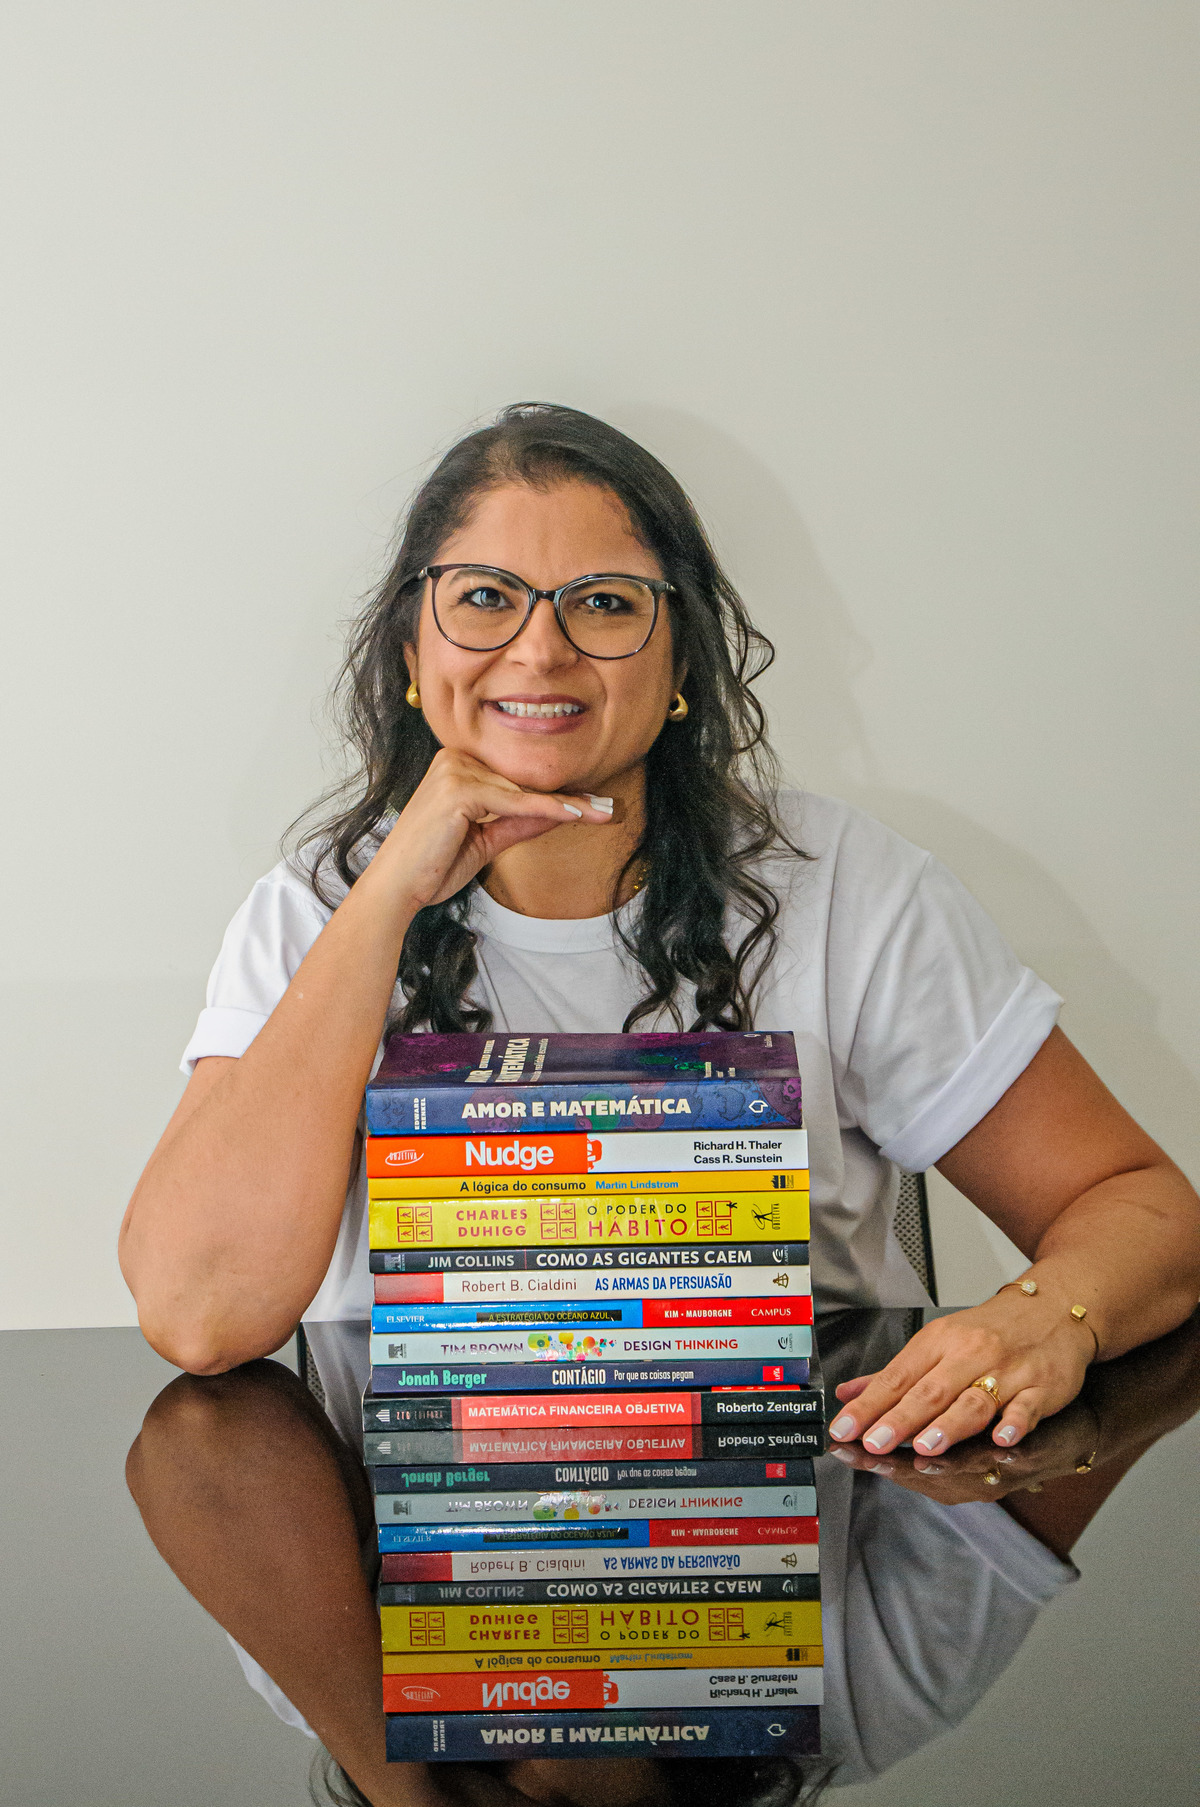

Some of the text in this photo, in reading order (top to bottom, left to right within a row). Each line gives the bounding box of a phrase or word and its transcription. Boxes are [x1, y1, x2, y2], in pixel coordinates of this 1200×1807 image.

[462, 1095, 692, 1119] AMOR E MATEMÁTICA
[694, 1140, 782, 1151] Richard H. Thaler
[465, 1140, 554, 1170] Nudge
[694, 1154, 782, 1164] Cass R. Sunstein
[460, 1181, 586, 1194] A lógica do consumo
[596, 1180, 679, 1190] Martin Lindstrom
[456, 1209, 527, 1221] CHARLES
[587, 1204, 687, 1215] O PODER DO
[458, 1225, 527, 1238] DUHIGG
[588, 1216, 688, 1237] HÁBITO
[428, 1255, 515, 1269] JIM COLLINS
[536, 1250, 752, 1267] COMO AS GIGANTES CAEM
[462, 1278, 577, 1292] Robert B. Cialdini
[595, 1273, 732, 1291] AS ARMAS DA PERSUASÃO
[556, 1312, 588, 1320] OCEANO
[590, 1312, 610, 1320] AZUL
[664, 1309, 732, 1318] KIM MAUBORGNE
[751, 1308, 791, 1317] CAMPUS
[386, 1315, 425, 1324] ELSEVIER
[441, 1343, 523, 1357] TIM BROWN
[624, 1339, 738, 1351] DESIGN THINKING
[398, 1370, 487, 1389] Jonah Berger
[552, 1366, 606, 1386] CONTÁGIO
[614, 1370, 694, 1383] Por que as coisas pegam
[468, 1403, 684, 1417] MATEMÁTICA FINANCEIRA OBJETIVA
[717, 1401, 817, 1415] Roberto Zentgraf
